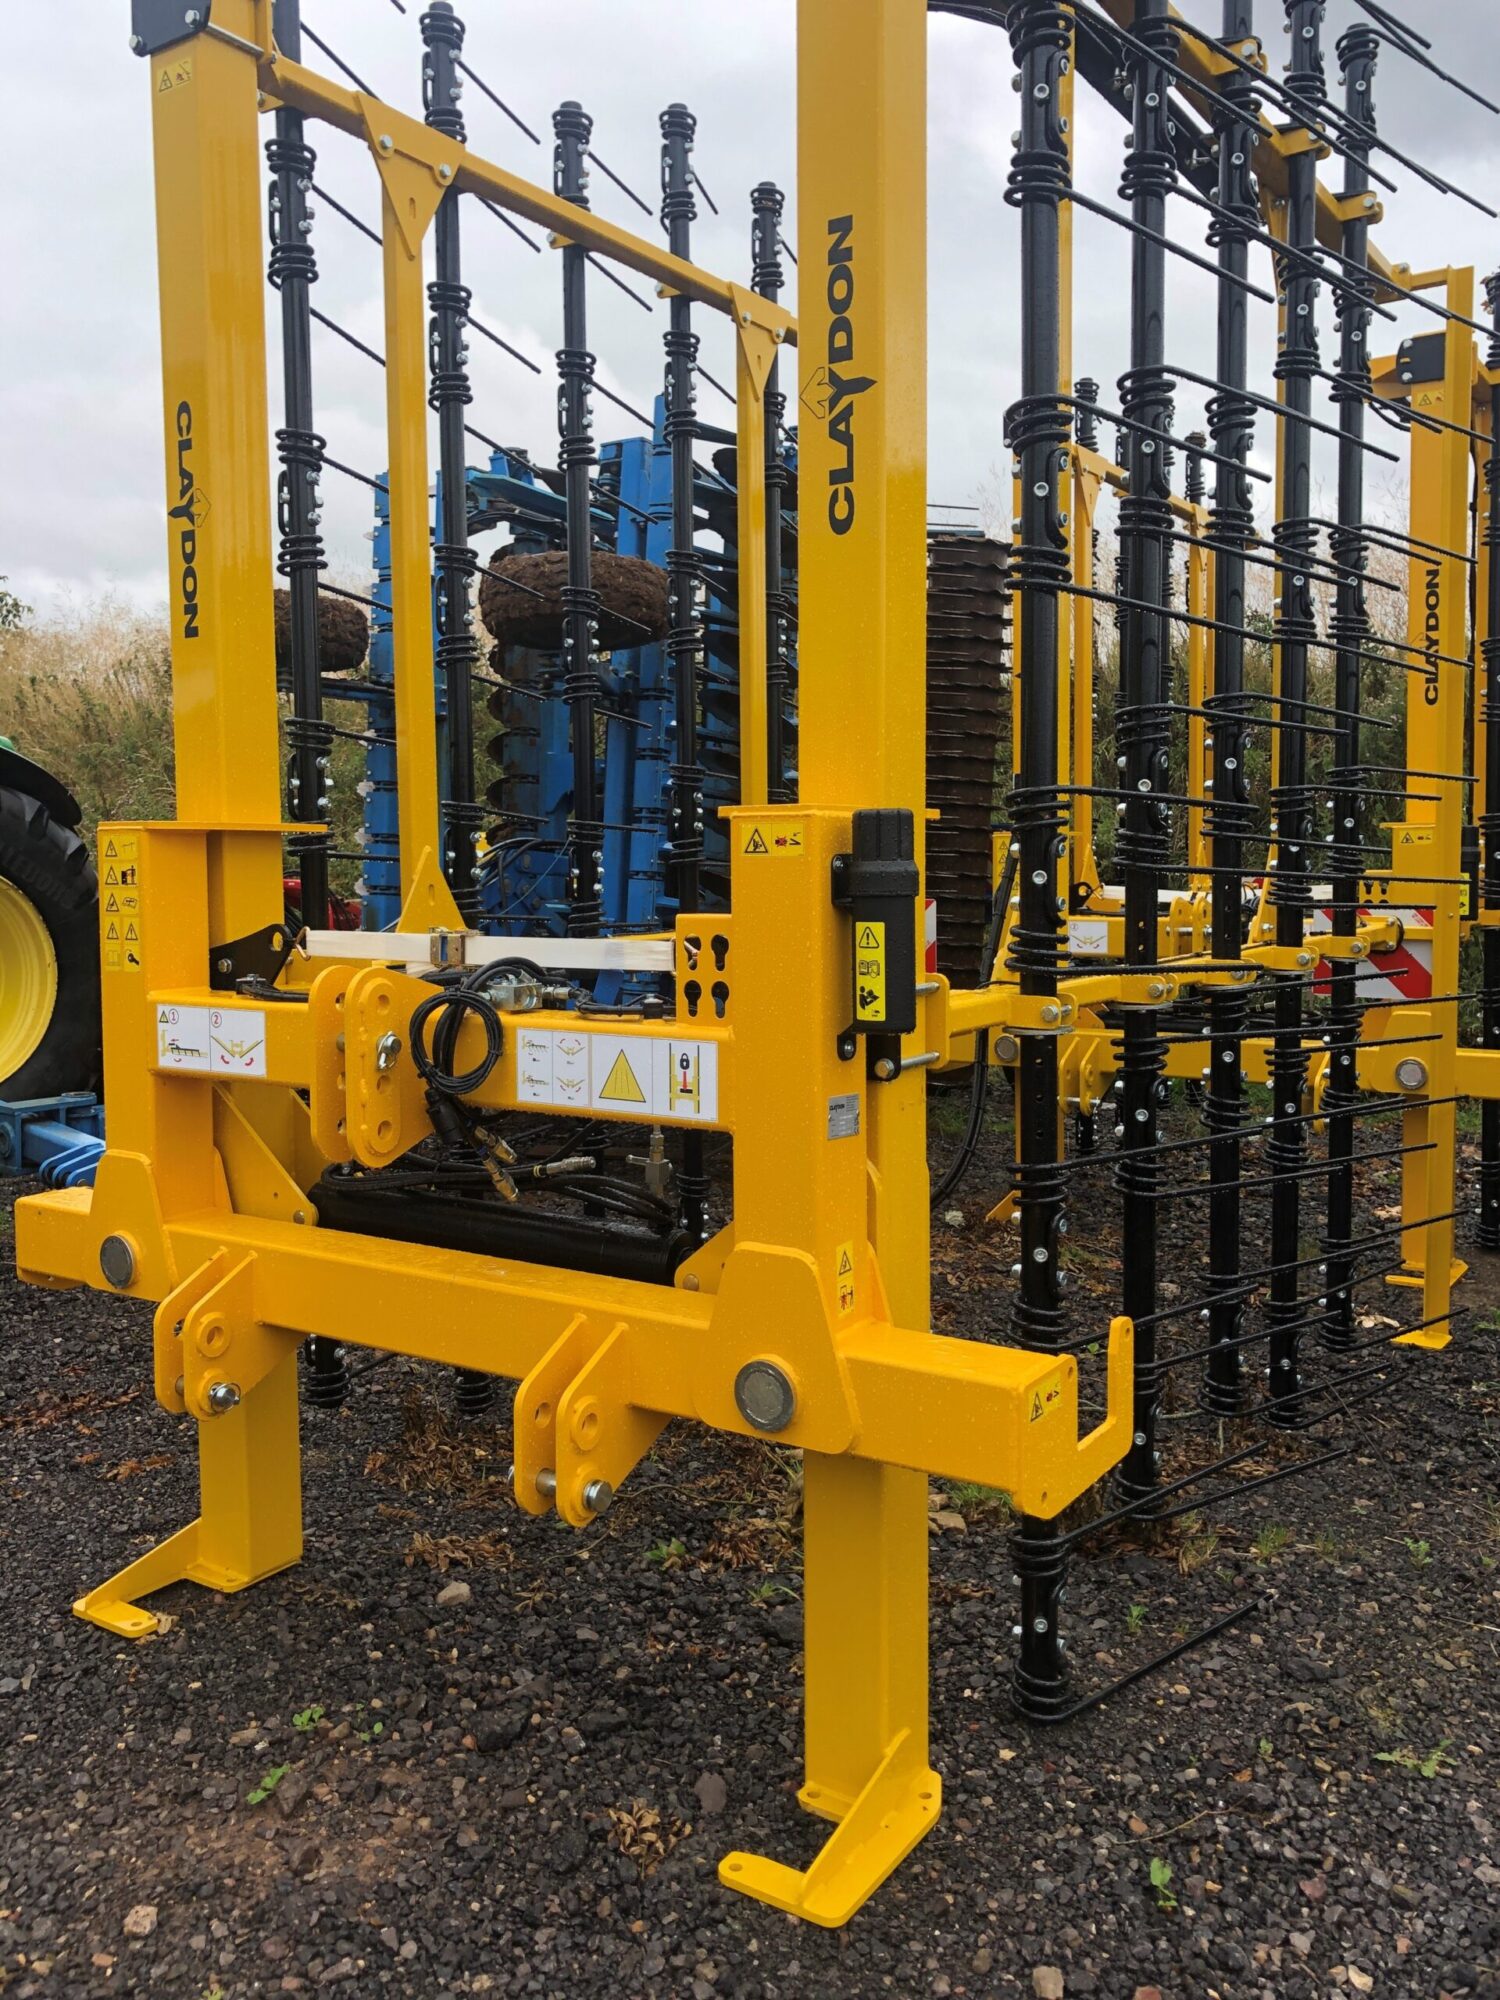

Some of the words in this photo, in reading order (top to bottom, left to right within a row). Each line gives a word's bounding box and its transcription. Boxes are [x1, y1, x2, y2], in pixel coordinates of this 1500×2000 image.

[827, 214, 878, 536] CLAYDON
[167, 400, 200, 639] CLAYDON
[1424, 568, 1440, 706] CLAYDON
